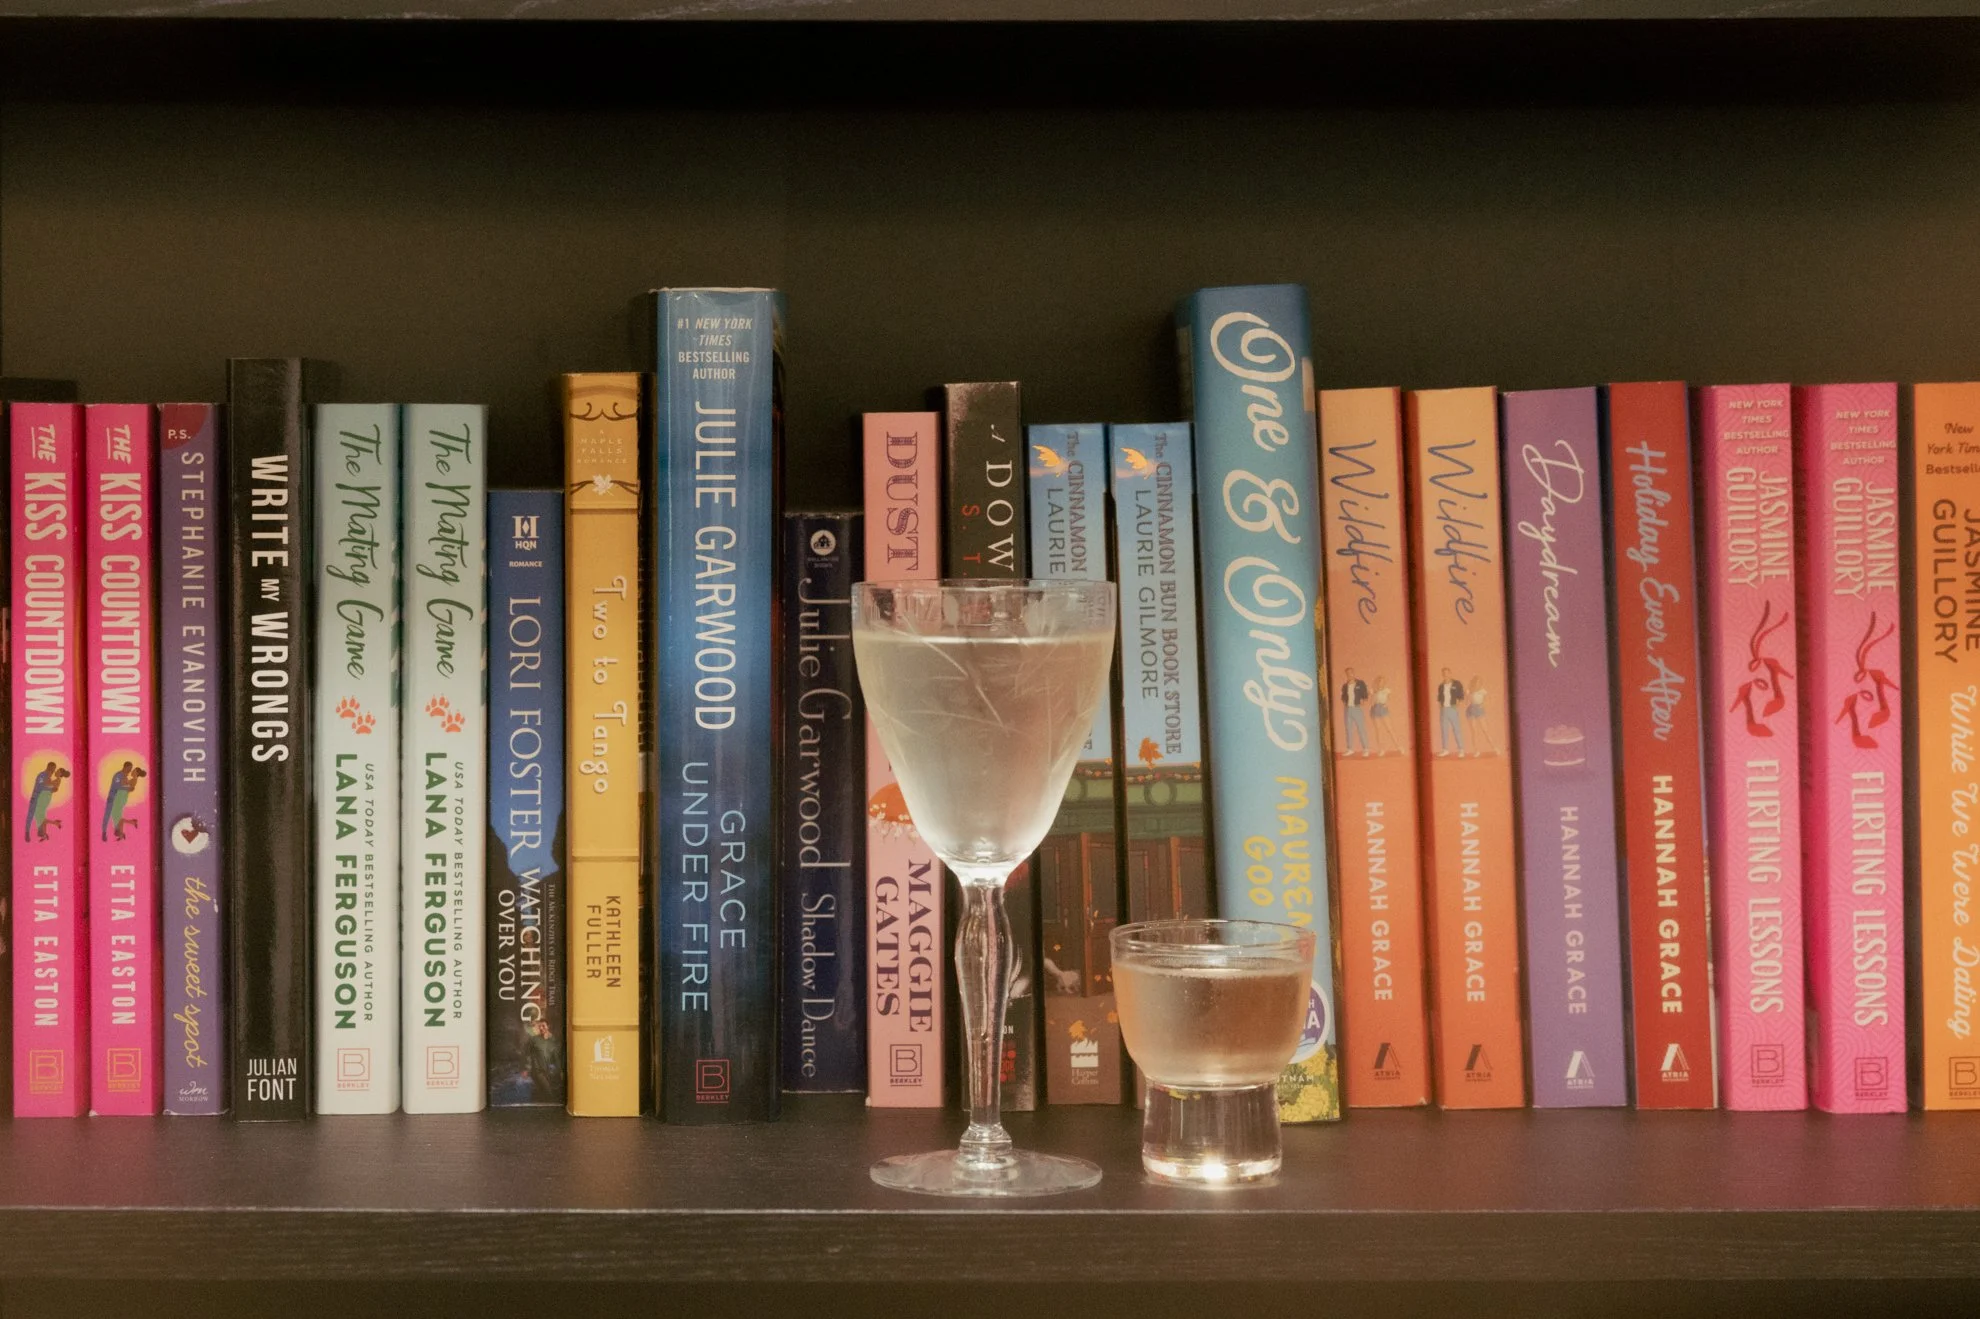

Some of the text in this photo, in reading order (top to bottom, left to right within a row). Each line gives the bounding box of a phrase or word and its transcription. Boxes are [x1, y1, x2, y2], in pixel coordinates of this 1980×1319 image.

[677, 318, 753, 330] #1 NEW YORK
[678, 351, 750, 363] BESTSELLING
[692, 367, 736, 380] AUTHOR
[699, 334, 732, 346] TIMES
[168, 428, 191, 440] P.S.
[1067, 431, 1079, 456] The
[1723, 430, 1790, 440] BESTSELLING
[1728, 400, 1784, 409] NEW YORK
[1736, 445, 1779, 455] AUTHOR
[1741, 415, 1773, 424] TIMES
[1830, 440, 1897, 451] BESTSELLING
[1835, 410, 1890, 419] NEW YORK
[1842, 455, 1885, 465] AUTHOR
[1848, 425, 1879, 434] TIMES
[1926, 442, 1980, 455] York Tim
[1944, 422, 1974, 434] New
[24, 424, 67, 734] THE KISS COUNTDOWN
[100, 424, 142, 734] THE KISS COUNTDOWN
[326, 423, 384, 680] The Mating Game
[416, 422, 474, 679] The Mating Game
[509, 560, 543, 568] ROMANCE
[515, 540, 537, 551] HQN
[694, 401, 737, 730] JULIE GARWOOD
[886, 431, 919, 571] DUST
[1047, 487, 1066, 575] LAURIE
[1068, 460, 1088, 572] CINNAMON
[1211, 311, 1314, 751] One & Only
[1327, 439, 1393, 625] Wildfire
[1427, 439, 1491, 625] Wildfire
[1518, 439, 1585, 668] Daydream
[1726, 466, 1758, 590] GUILLORY
[1760, 472, 1790, 583] JASMINE
[1833, 476, 1865, 601] GUILLORY
[1866, 482, 1897, 594] JASMINE
[181, 452, 207, 782] STEPHANIE EVANOVICH
[251, 454, 289, 763] WRITE MY WRONGS
[797, 578, 851, 678] Julie
[1135, 488, 1159, 700] LAURIE GILMORE
[1154, 433, 1182, 754] The CINNAMON BUN BOOK STORE
[1625, 440, 1685, 742] Holiday Ever After
[1933, 498, 1958, 663] GUILLORY
[509, 597, 542, 858] LORI FOSTER
[579, 575, 628, 794] Two to Tango
[797, 688, 852, 868] Garwood
[334, 753, 358, 1029] LANA FERGUSON
[363, 763, 375, 1022] USA TODAY BESTSELLING AUTHOR
[423, 752, 448, 1027] LANA FERGUSON
[453, 761, 464, 1020] USA TODAY BESTSELLING AUTHOR
[586, 904, 601, 979] FULLER
[681, 761, 709, 1012] UNDER FIRE
[720, 809, 746, 948] GRACE
[1243, 835, 1276, 907] GOO
[1365, 802, 1393, 1000] HANNAH GRACE
[1460, 803, 1486, 1002] HANNAH GRACE
[1560, 806, 1587, 1014] HANNAH GRACE
[1652, 775, 1683, 1013] HANNAH GRACE
[1746, 760, 1784, 1014] FLIRTING LESSONS
[1851, 771, 1889, 1027] FLIRTING LESSONS
[1947, 684, 1980, 1041] While We Were Dating
[33, 866, 58, 1026] ETTA EASTON
[111, 865, 136, 1025] ETTA EASTON
[173, 876, 210, 1068] the sweet spot
[498, 889, 516, 1002] OVER YOU
[520, 868, 541, 1024] WATCHING
[605, 895, 621, 989] KATHLEEN
[801, 893, 836, 1078] Shadow Dance
[875, 875, 900, 1016] GATES
[908, 859, 933, 1033] MAGGIE
[247, 1058, 297, 1076] JULIAN
[247, 1080, 297, 1101] FONT
